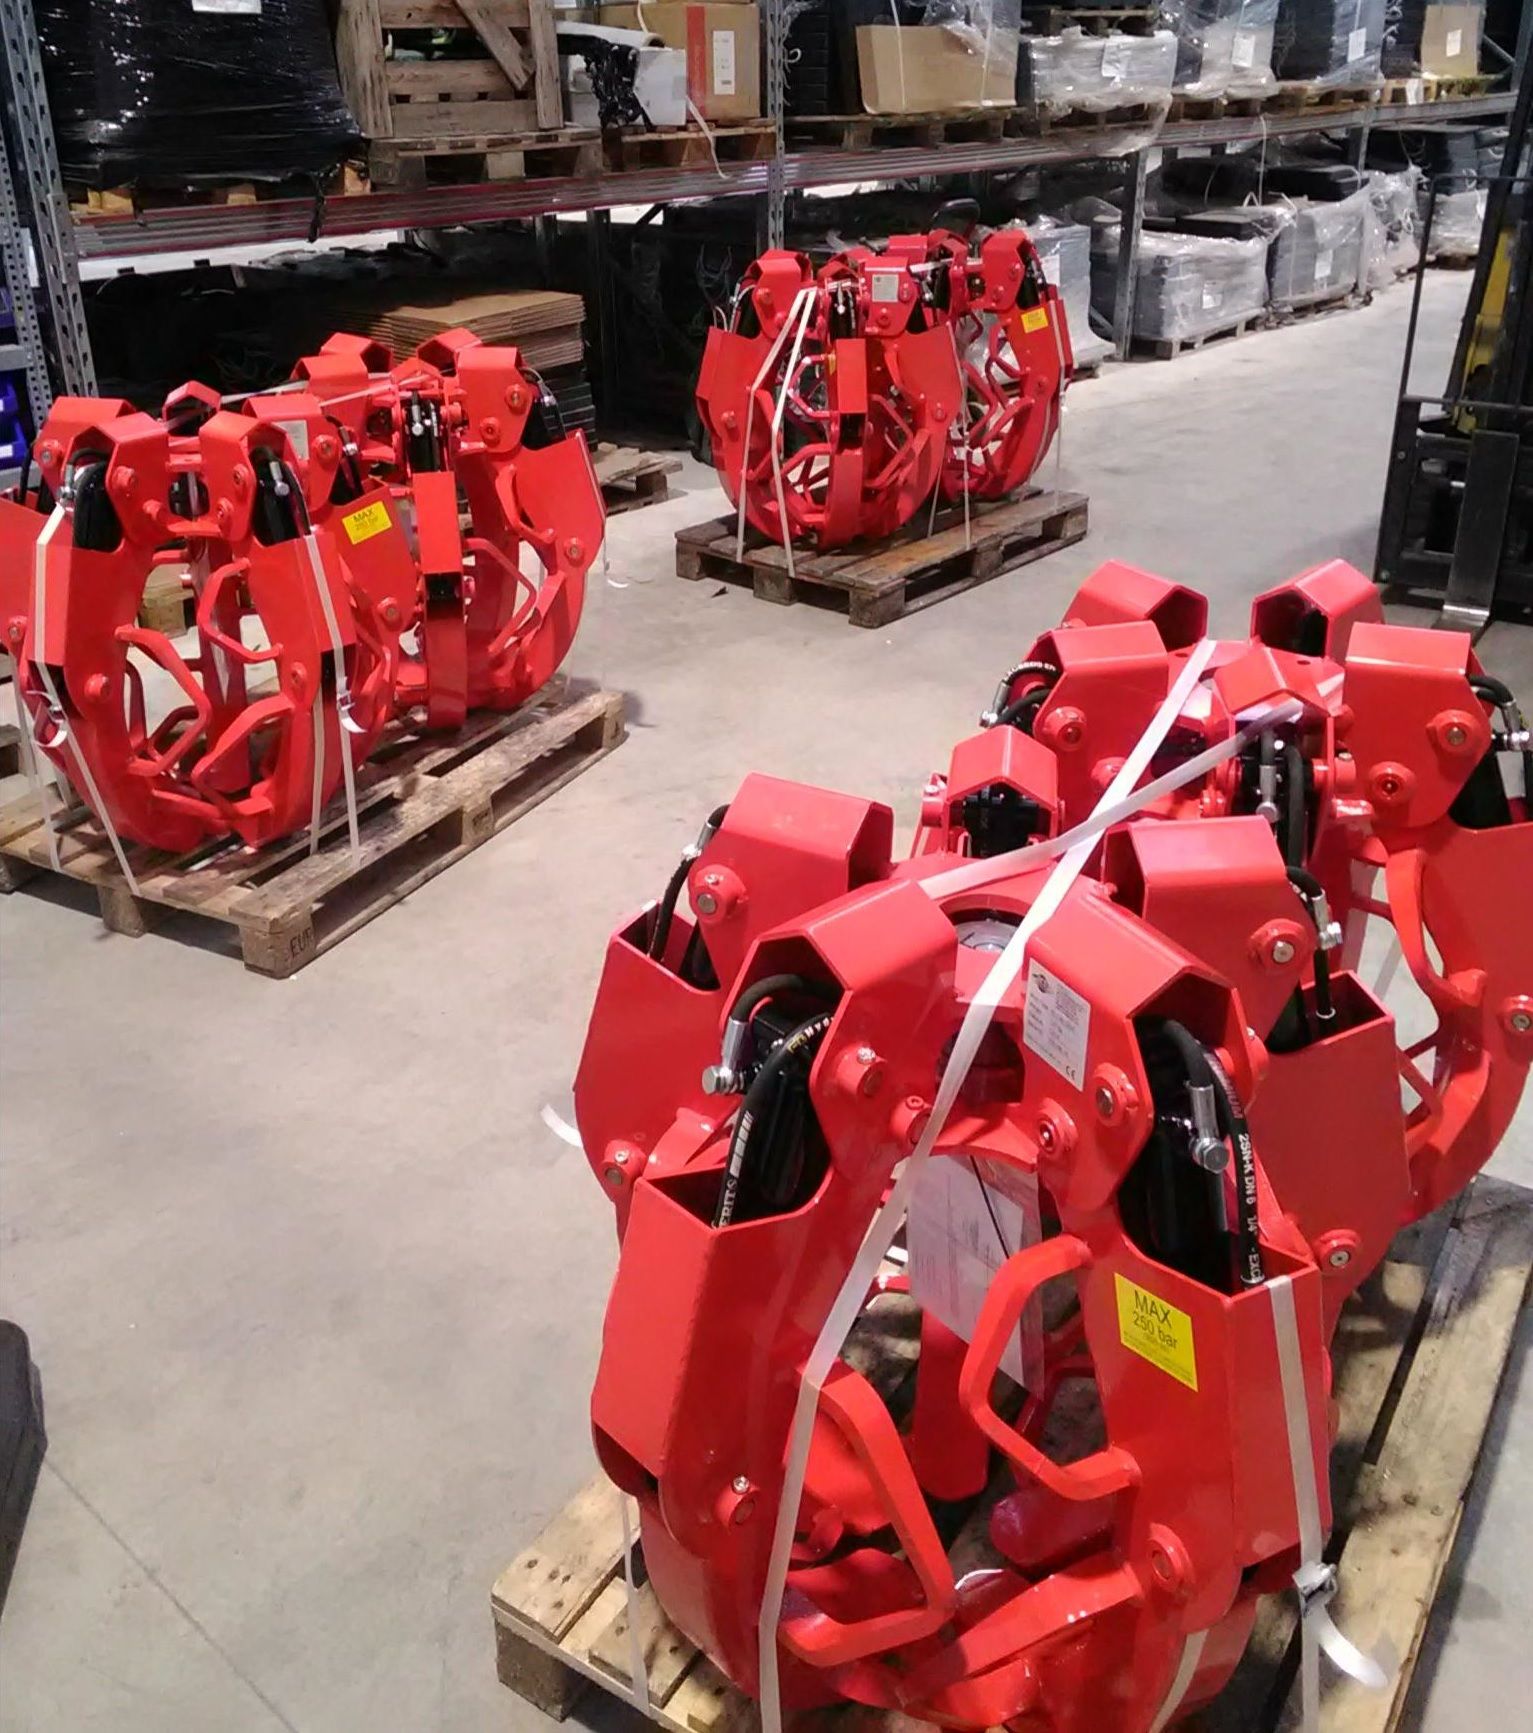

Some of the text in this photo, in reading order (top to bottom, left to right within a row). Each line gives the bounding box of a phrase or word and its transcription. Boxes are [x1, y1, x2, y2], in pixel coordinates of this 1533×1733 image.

[1244, 1175, 1257, 1195] DN
[1134, 1289, 1172, 1328] MAX
[1132, 1311, 1154, 1336] 250
[1156, 1325, 1179, 1349] bar
